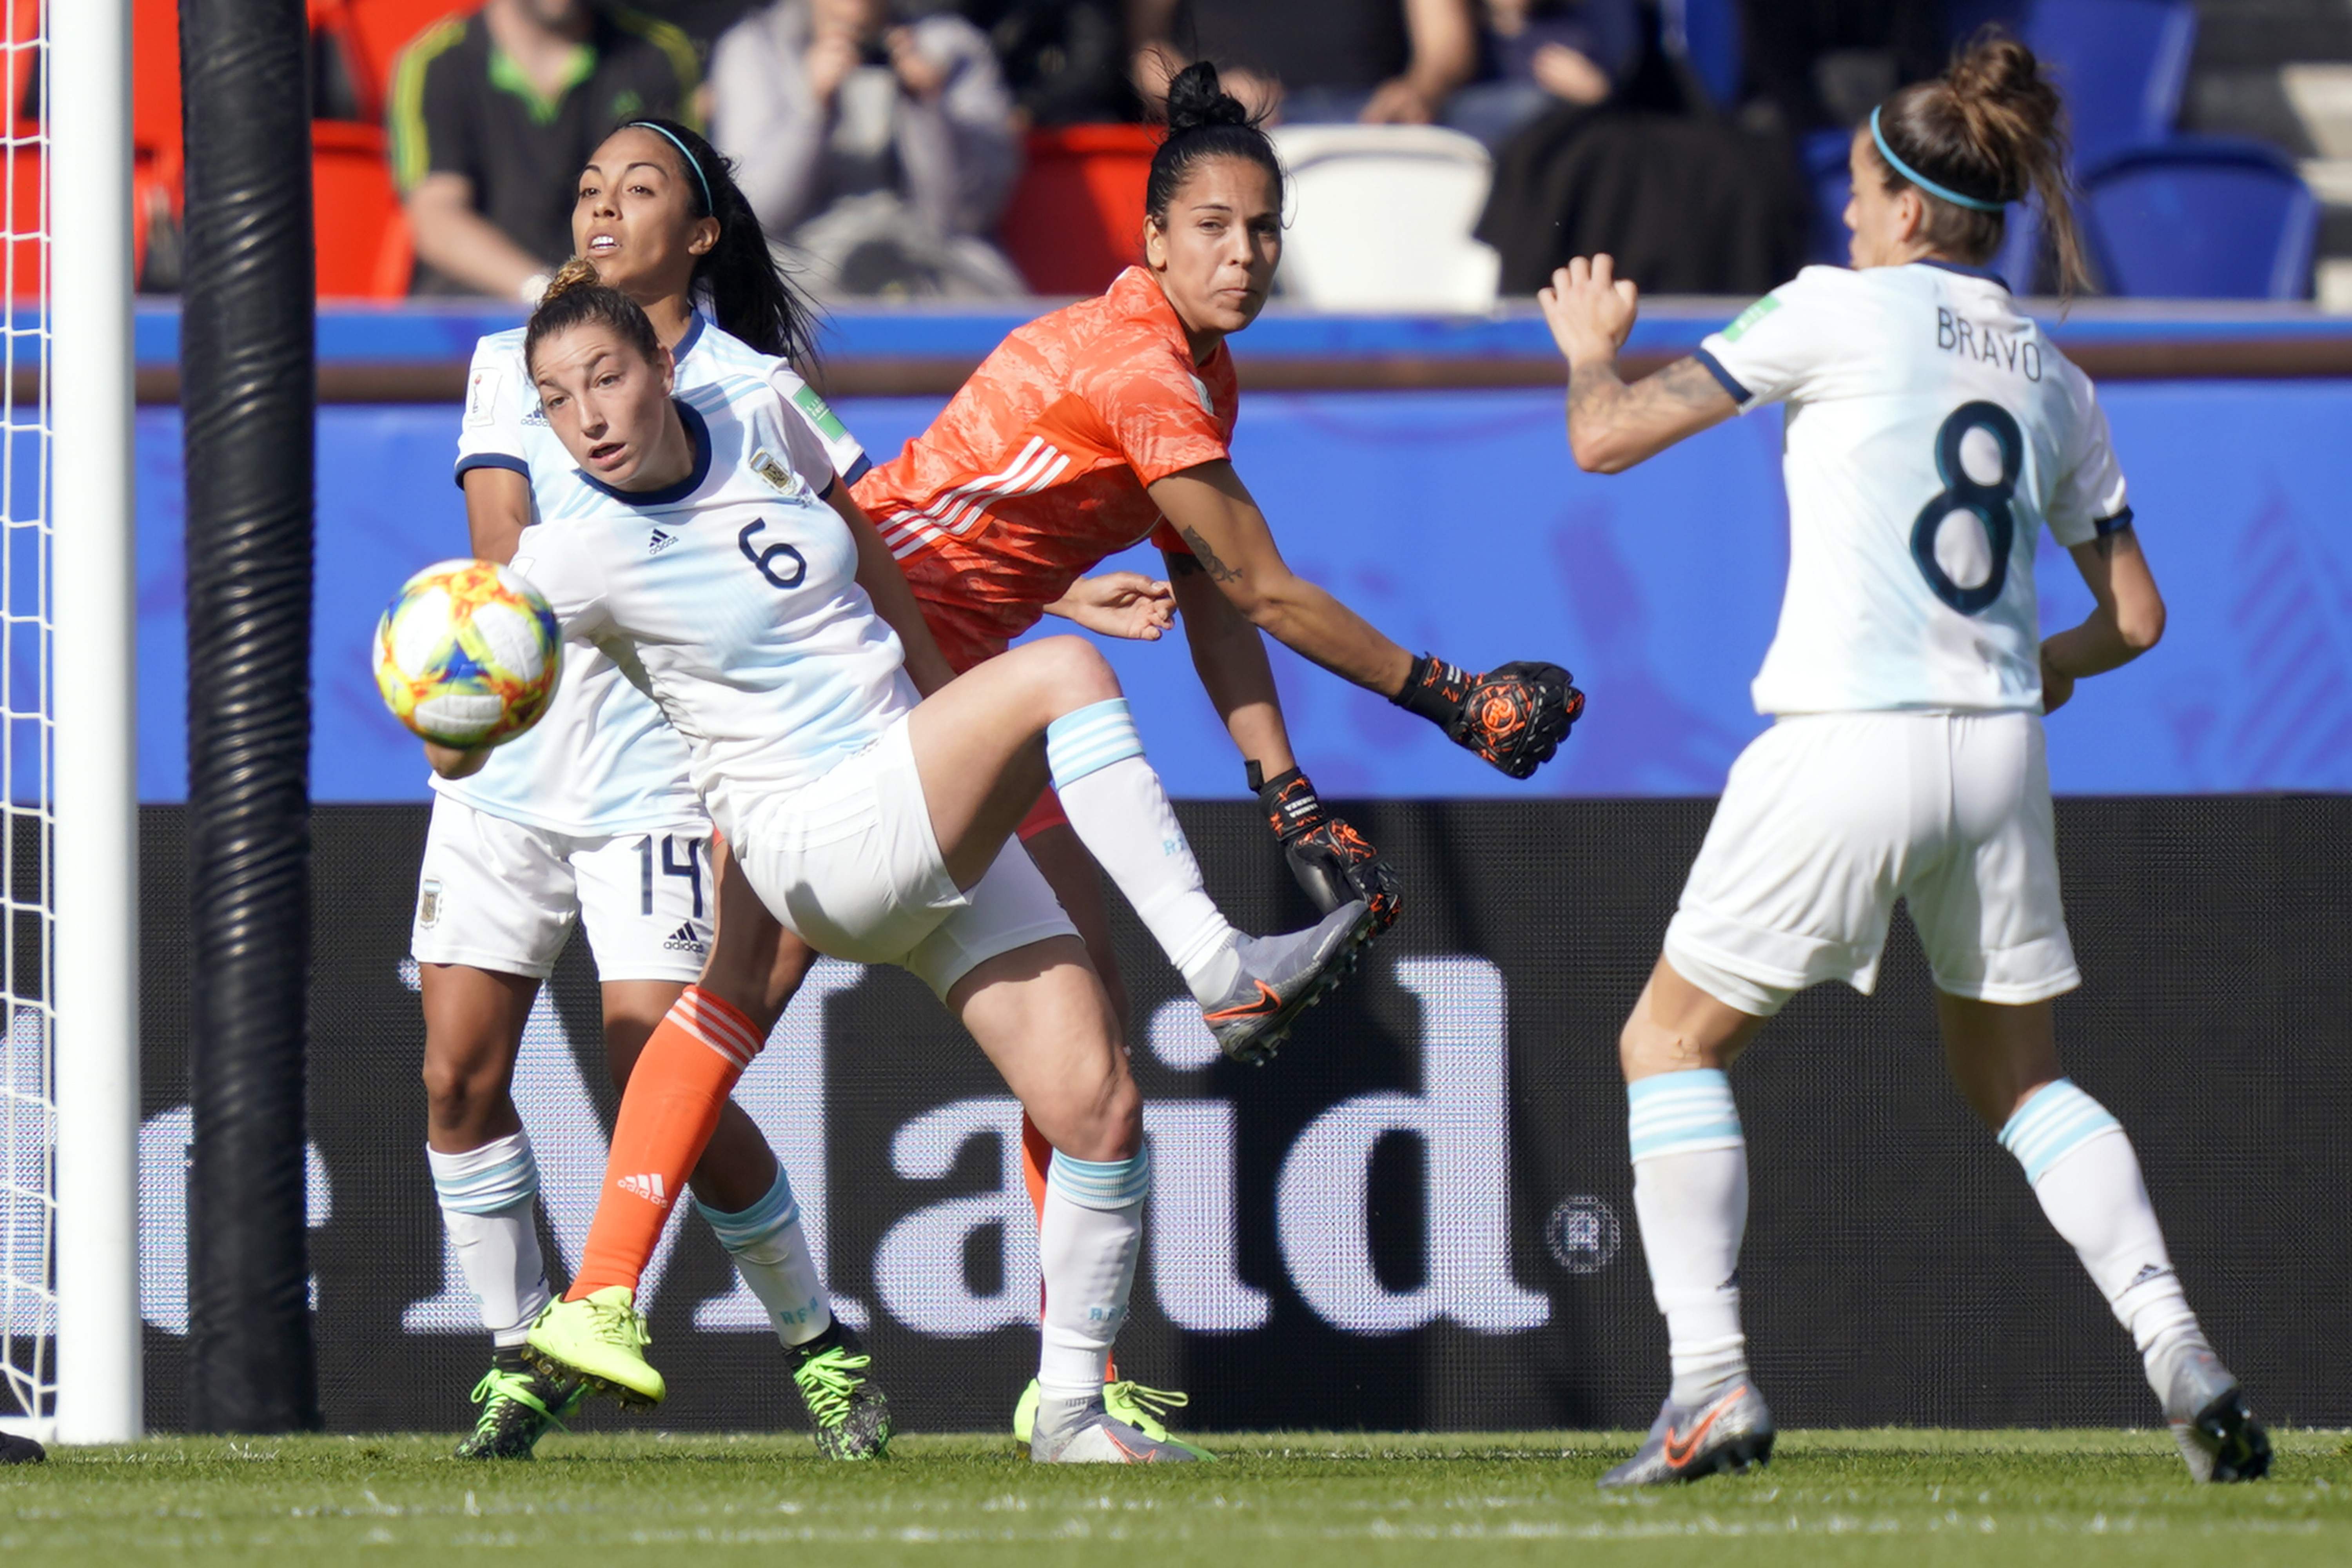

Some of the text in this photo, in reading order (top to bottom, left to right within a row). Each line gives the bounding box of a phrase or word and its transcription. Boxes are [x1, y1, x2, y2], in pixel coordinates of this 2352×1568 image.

[1936, 307, 2042, 383] BRAVO
[1910, 400, 2023, 616] 8
[649, 536, 679, 555] adidas
[738, 517, 807, 589] 6
[632, 833, 703, 918] 14
[663, 940, 704, 953] adidas
[617, 1177, 668, 1209] adidas
